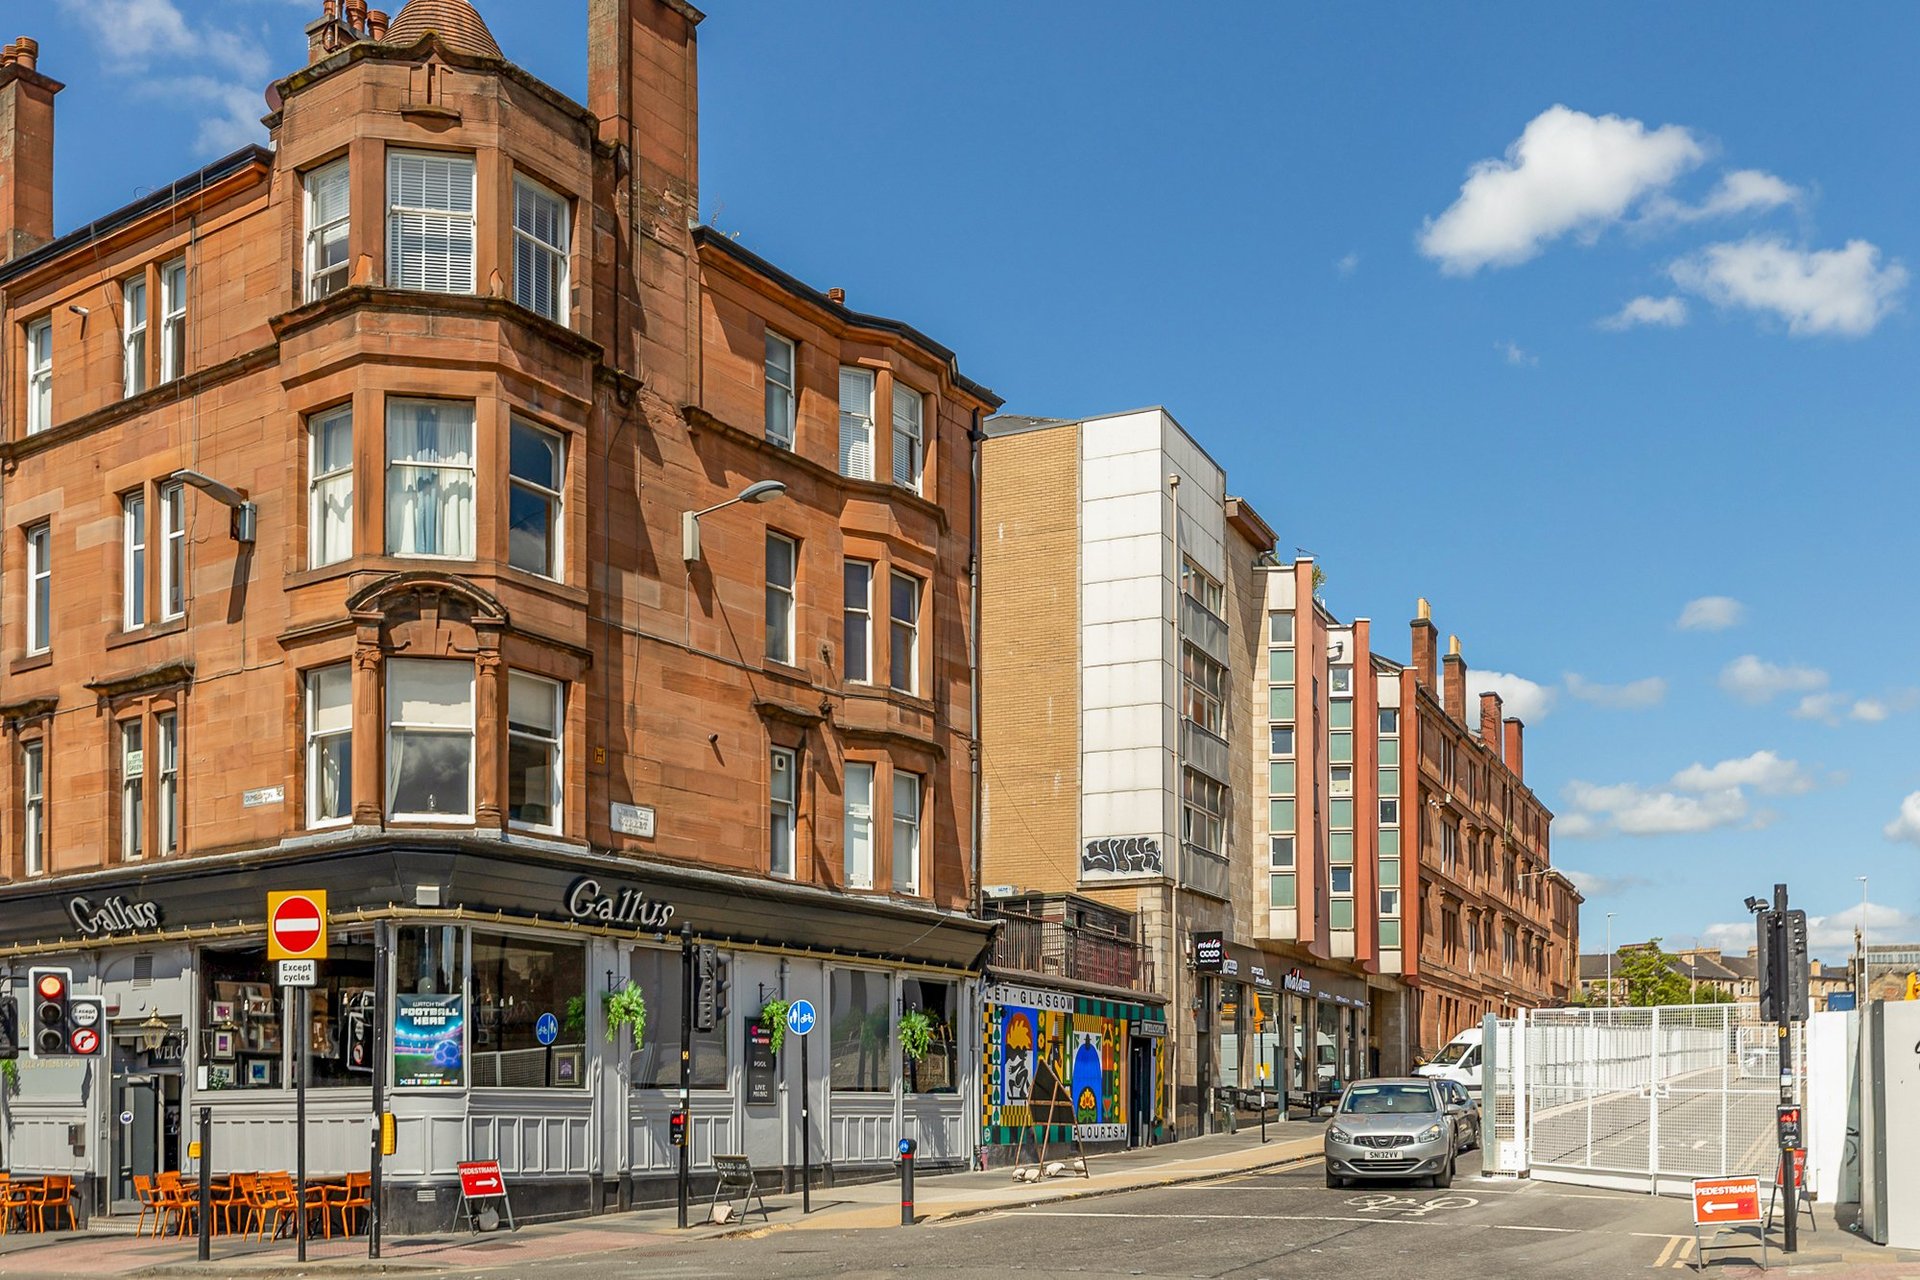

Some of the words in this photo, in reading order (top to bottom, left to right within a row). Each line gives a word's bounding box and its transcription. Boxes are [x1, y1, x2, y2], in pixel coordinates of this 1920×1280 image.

[570, 880, 675, 927] Gallus
[70, 896, 158, 934] Gallus
[282, 963, 312, 972] Except
[283, 973, 311, 983] cycles
[985, 987, 1009, 1002] LET
[1020, 991, 1074, 1010] GLASGOW
[400, 1008, 459, 1016] FOOTBALL
[413, 1016, 446, 1025] HERE
[753, 1060, 767, 1068] POOL
[1073, 1125, 1126, 1139] FLOURISH
[460, 1166, 498, 1175] PEDESTRIANS
[1696, 1184, 1757, 1196] PEDESTRIANS
